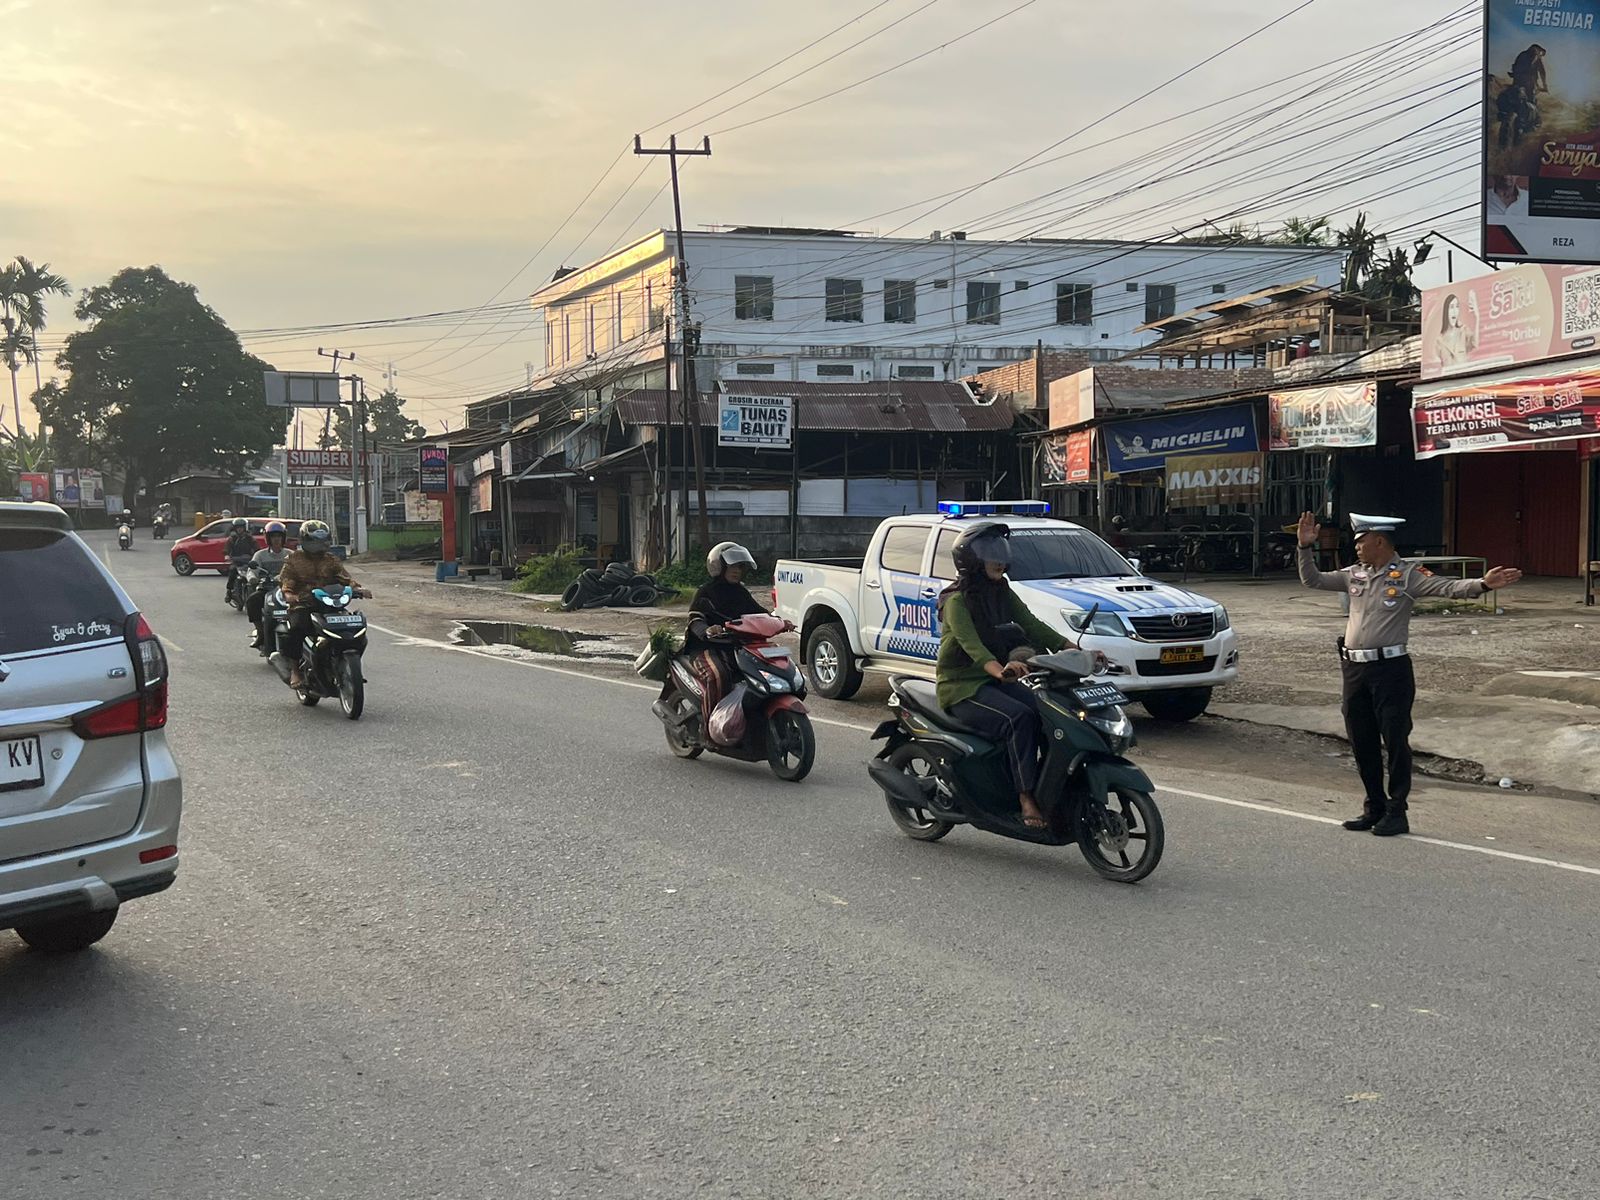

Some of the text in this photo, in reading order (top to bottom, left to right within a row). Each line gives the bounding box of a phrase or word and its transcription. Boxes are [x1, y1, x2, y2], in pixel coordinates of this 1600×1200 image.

[1524, 9, 1594, 30] BERSINAR
[1541, 141, 1600, 176] Surya
[1552, 238, 1575, 247] REZA
[728, 396, 752, 405] GROSIR
[1554, 388, 1583, 409] Sakti
[740, 407, 788, 422] TUNAS
[1425, 401, 1501, 425] TELKOMSEL
[740, 422, 786, 437] BAUT
[1426, 418, 1502, 435] TERBAIK DI SINI
[1151, 426, 1246, 450] MICHELIN
[290, 451, 349, 466] SUMBER
[422, 450, 446, 462] BUNDA
[1169, 466, 1261, 491] MAXXIS
[778, 570, 804, 584] UNIT LAKA
[900, 603, 931, 629] POLISI
[8, 740, 33, 768] KV
